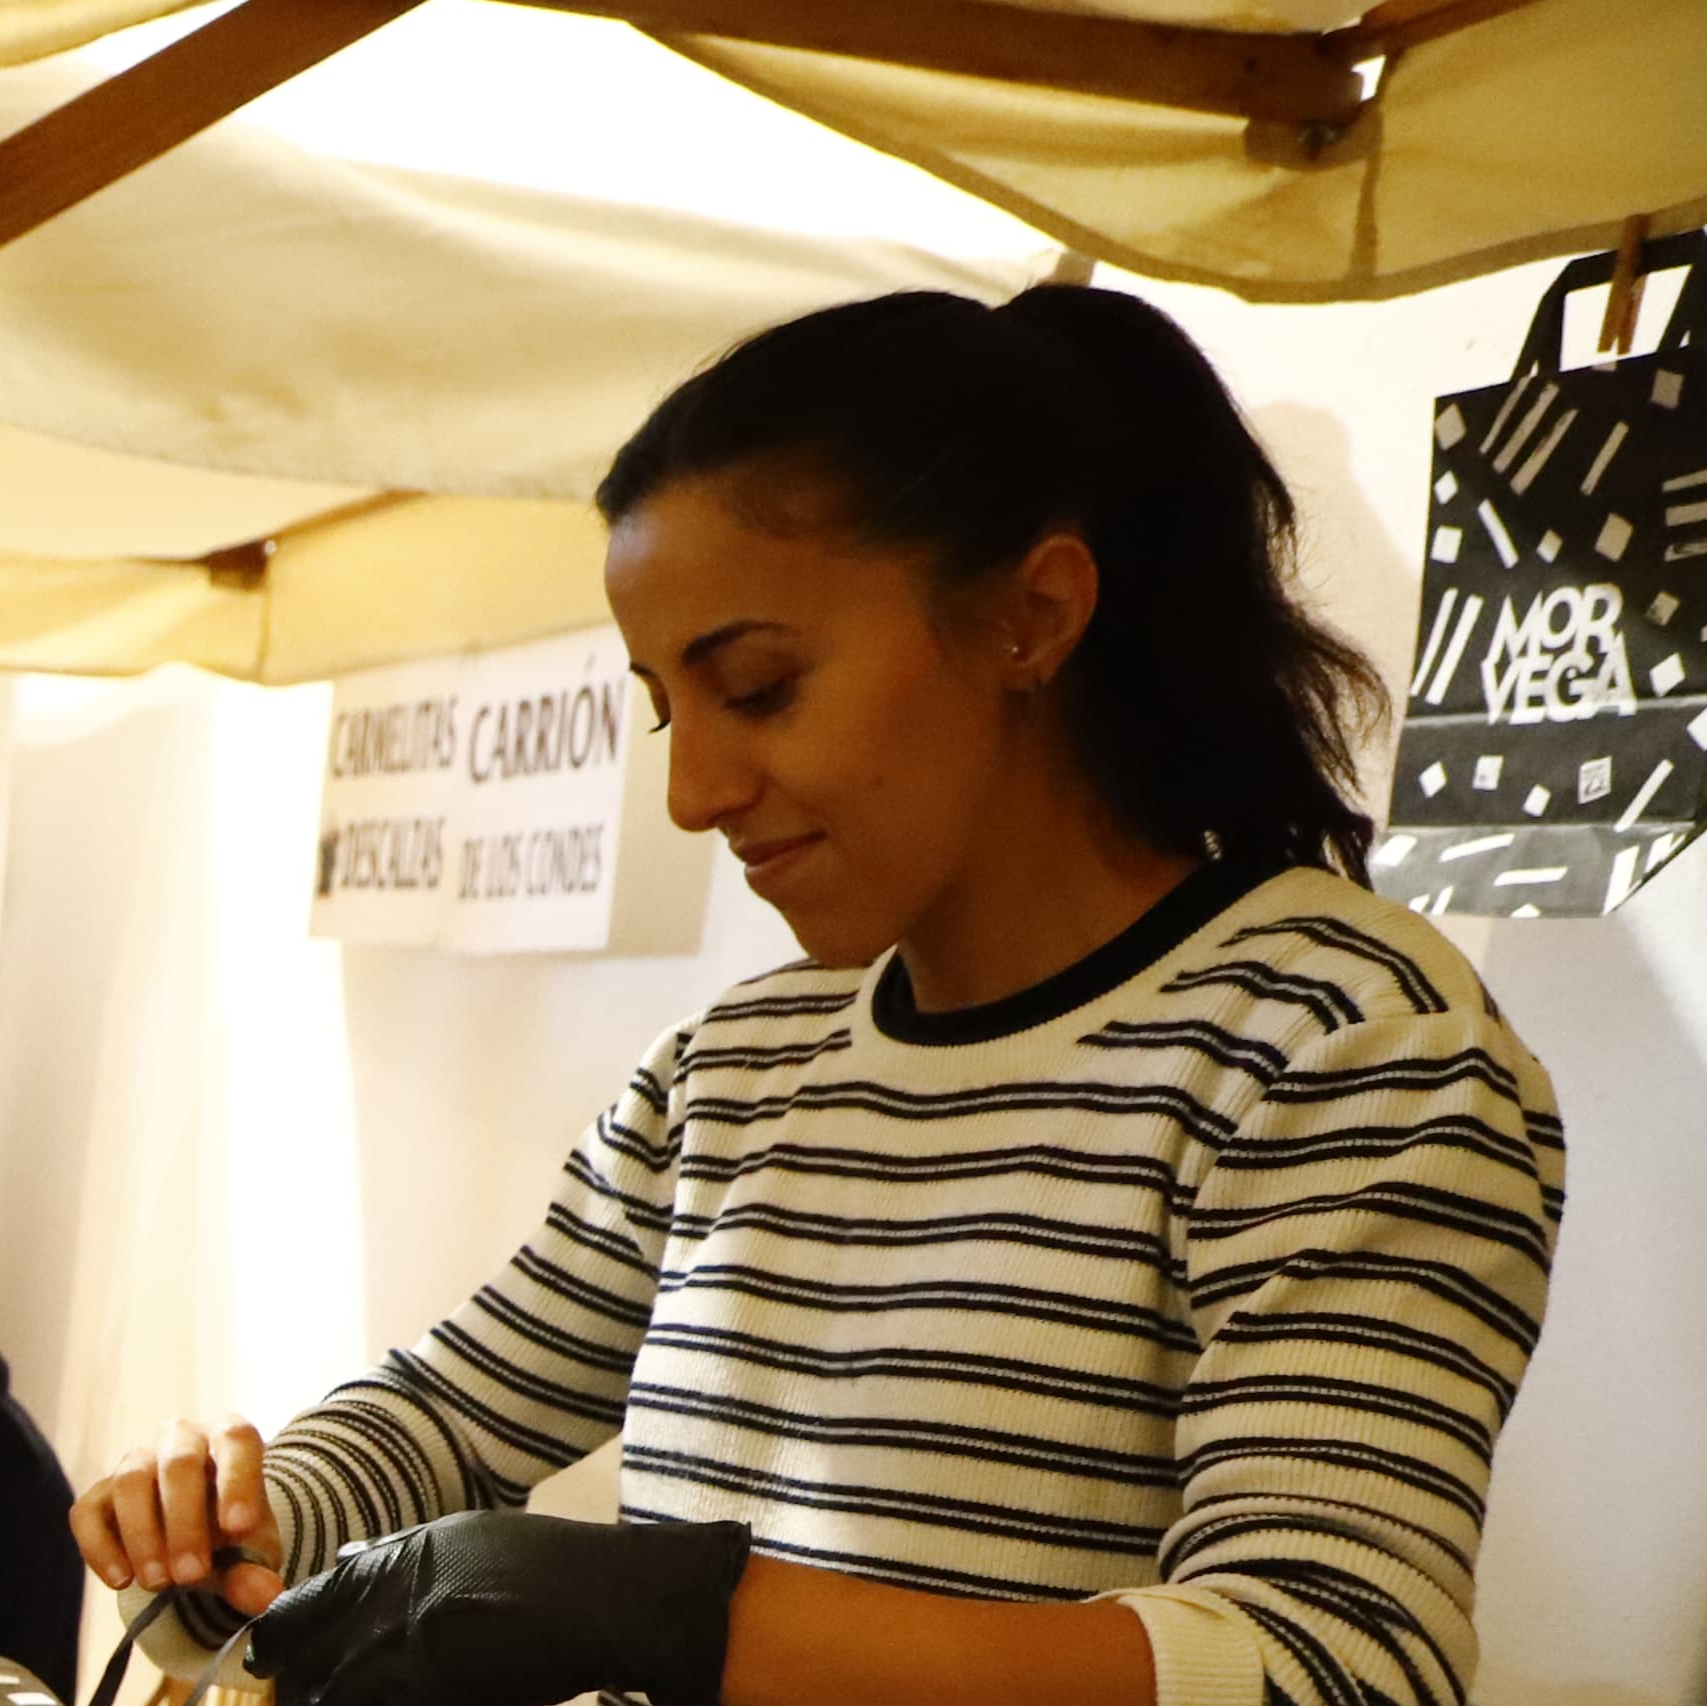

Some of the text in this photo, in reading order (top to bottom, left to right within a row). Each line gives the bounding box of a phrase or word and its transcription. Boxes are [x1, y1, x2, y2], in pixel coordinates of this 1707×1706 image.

[1502, 584, 1625, 664] MOR
[469, 654, 628, 784] CARRIÓN
[1482, 632, 1637, 724] VEGA
